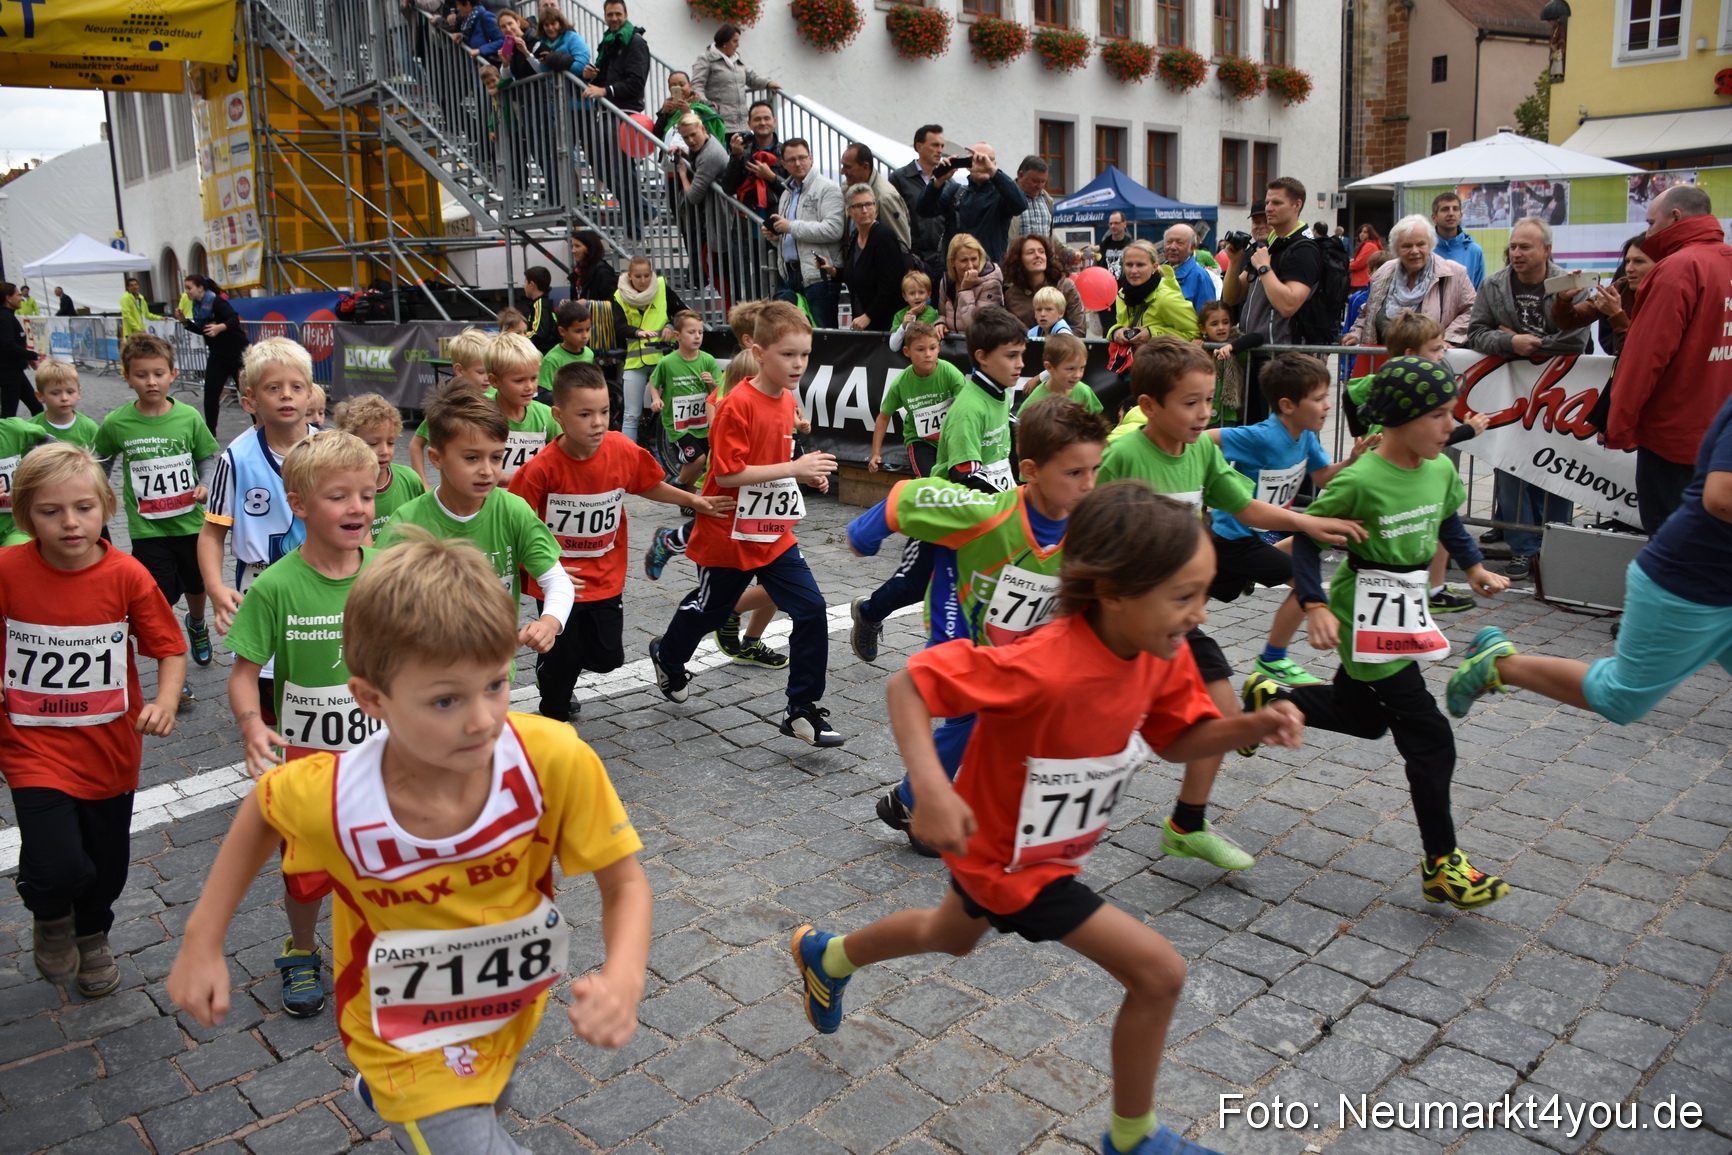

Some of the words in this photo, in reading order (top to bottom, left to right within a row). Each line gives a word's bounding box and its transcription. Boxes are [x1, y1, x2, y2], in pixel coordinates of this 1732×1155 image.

[84, 23, 151, 36] Neumarkter
[152, 26, 203, 40] Stadtlauf
[50, 61, 112, 71] Neumarkter
[113, 61, 159, 72] Stadtlauf
[1075, 212, 1104, 222] Tagblatt
[345, 347, 392, 370] BOCK
[907, 393, 938, 403] Neumarkter
[677, 403, 706, 419] 7184
[124, 437, 168, 447] Neumarkter
[126, 445, 160, 456] Stadtlauf
[153, 461, 185, 471] Neumarkt
[138, 468, 191, 497] 7419
[151, 498, 183, 511] ROBIN
[243, 487, 271, 516] 8
[549, 499, 578, 507] PARTL
[579, 497, 614, 508] Neumarkt
[748, 490, 800, 516] 7132
[555, 505, 616, 534] 7105
[1378, 503, 1438, 526] Neumarkter
[757, 521, 785, 533] Lukas
[1379, 517, 1429, 539] Stadtlauf
[1003, 574, 1037, 591] PARTL
[1359, 577, 1394, 588] PARTL
[9, 630, 45, 646] PARTL
[48, 635, 107, 647] Neumarkt
[1376, 636, 1434, 650] Leonhard
[17, 648, 112, 689] 7221
[39, 698, 89, 713] Julius
[285, 692, 325, 707] PARTL
[1029, 772, 1082, 786] PARTL
[361, 876, 455, 908] MAX
[374, 946, 442, 963] PARTL
[447, 925, 540, 952] Neumarkt
[393, 938, 552, 1000] 7148
[422, 998, 523, 1025] Andreas
